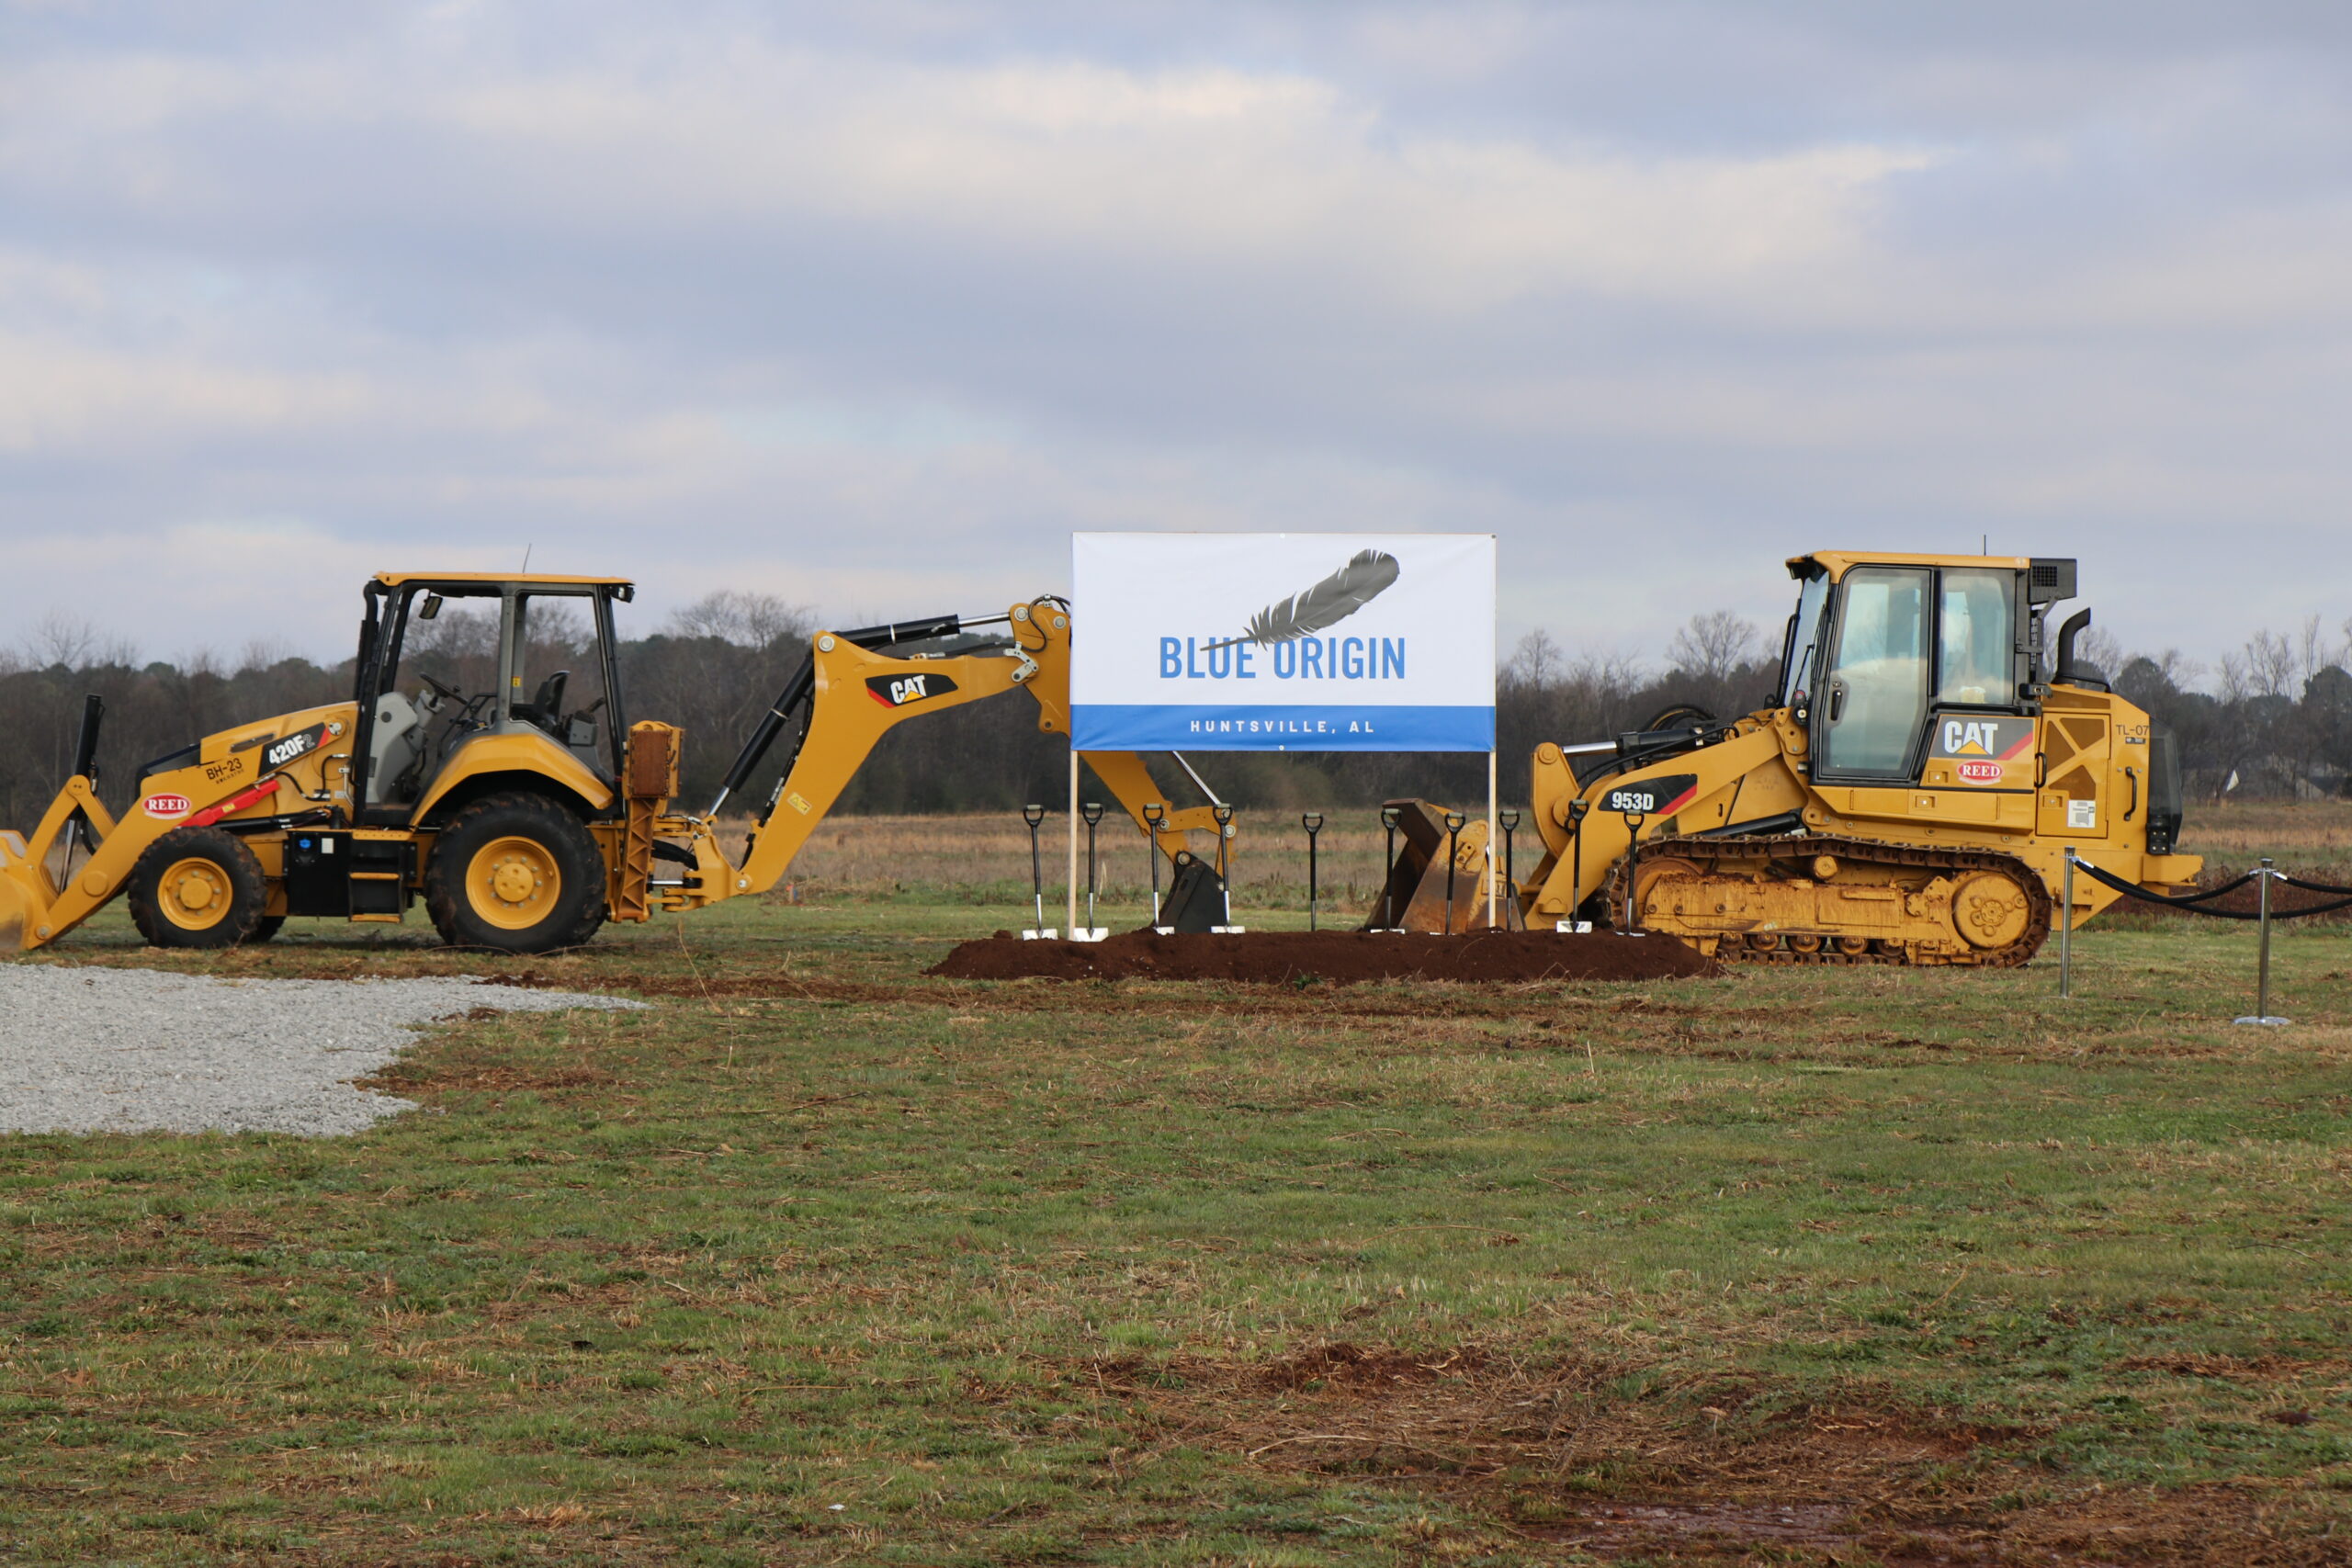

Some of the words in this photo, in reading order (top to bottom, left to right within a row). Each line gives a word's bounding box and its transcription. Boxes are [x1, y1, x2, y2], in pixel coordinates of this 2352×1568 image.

[1159, 637, 1257, 679] BLUE
[1273, 637, 1406, 680] ORIGIN
[890, 674, 927, 705] CAT
[1190, 720, 1336, 735] HUNTSVILLE,
[1349, 720, 1374, 734] AL
[1944, 720, 1999, 756] CAT
[268, 733, 316, 765] 420F2
[206, 757, 243, 780] BH-23
[1962, 764, 2001, 778] REED
[147, 798, 188, 812] REED
[1611, 791, 1655, 811] 953D
